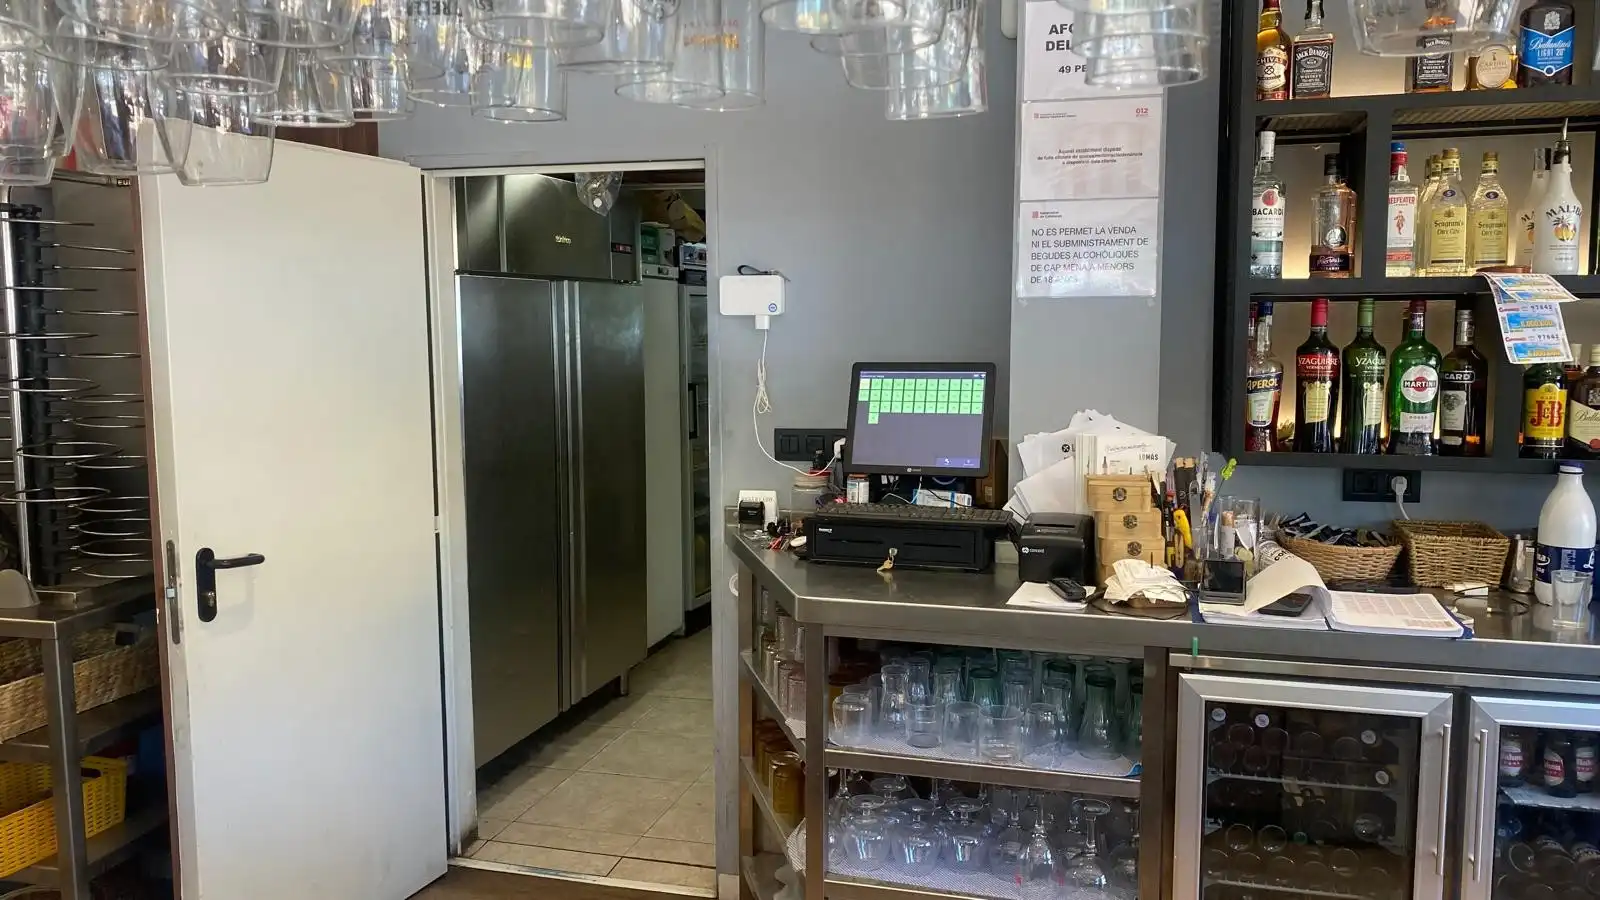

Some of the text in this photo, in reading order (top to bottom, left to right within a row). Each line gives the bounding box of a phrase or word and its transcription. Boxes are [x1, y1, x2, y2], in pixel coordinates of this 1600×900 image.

[1058, 65, 1071, 74] 49
[1059, 227, 1093, 235] PERMET
[1108, 226, 1137, 234] VENDA
[1041, 240, 1052, 248] EL
[1053, 238, 1135, 248] SUBMINISTRAMENT
[1136, 237, 1149, 246] DE
[1030, 252, 1071, 260] BEGUDES
[1030, 264, 1042, 272] DE
[1044, 264, 1061, 272] CAP
[1030, 276, 1042, 284] DE
[1044, 275, 1053, 283] 18
[1298, 357, 1339, 366] YZAGUIRRE
[1247, 378, 1279, 390] APEROL
